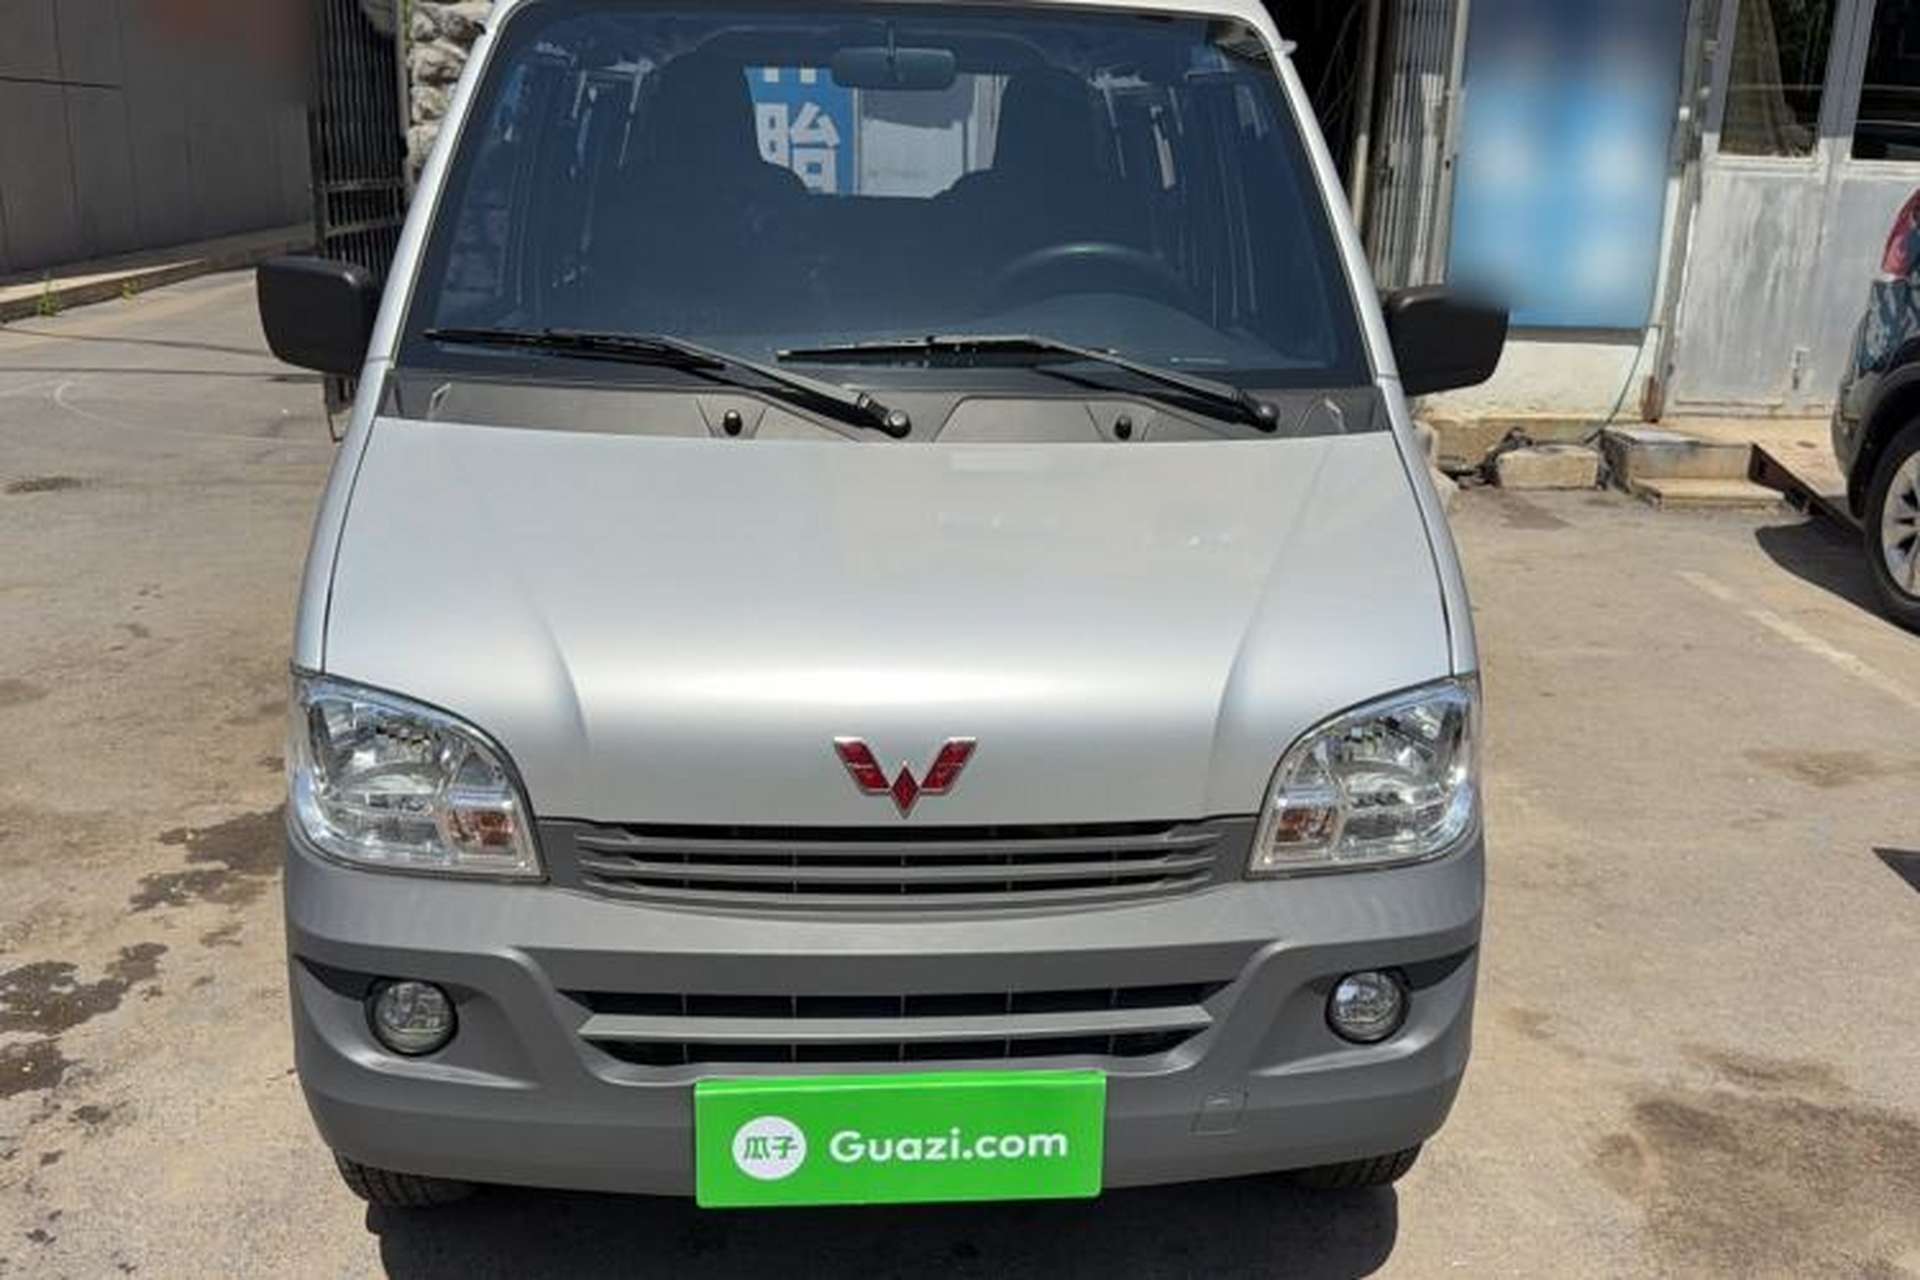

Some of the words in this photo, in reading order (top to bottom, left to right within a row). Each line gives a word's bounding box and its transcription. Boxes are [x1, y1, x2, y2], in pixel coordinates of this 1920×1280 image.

[755, 67, 841, 195] 胎
[742, 1134, 799, 1161] 瓜子
[829, 1128, 1068, 1163] Guazi.com
